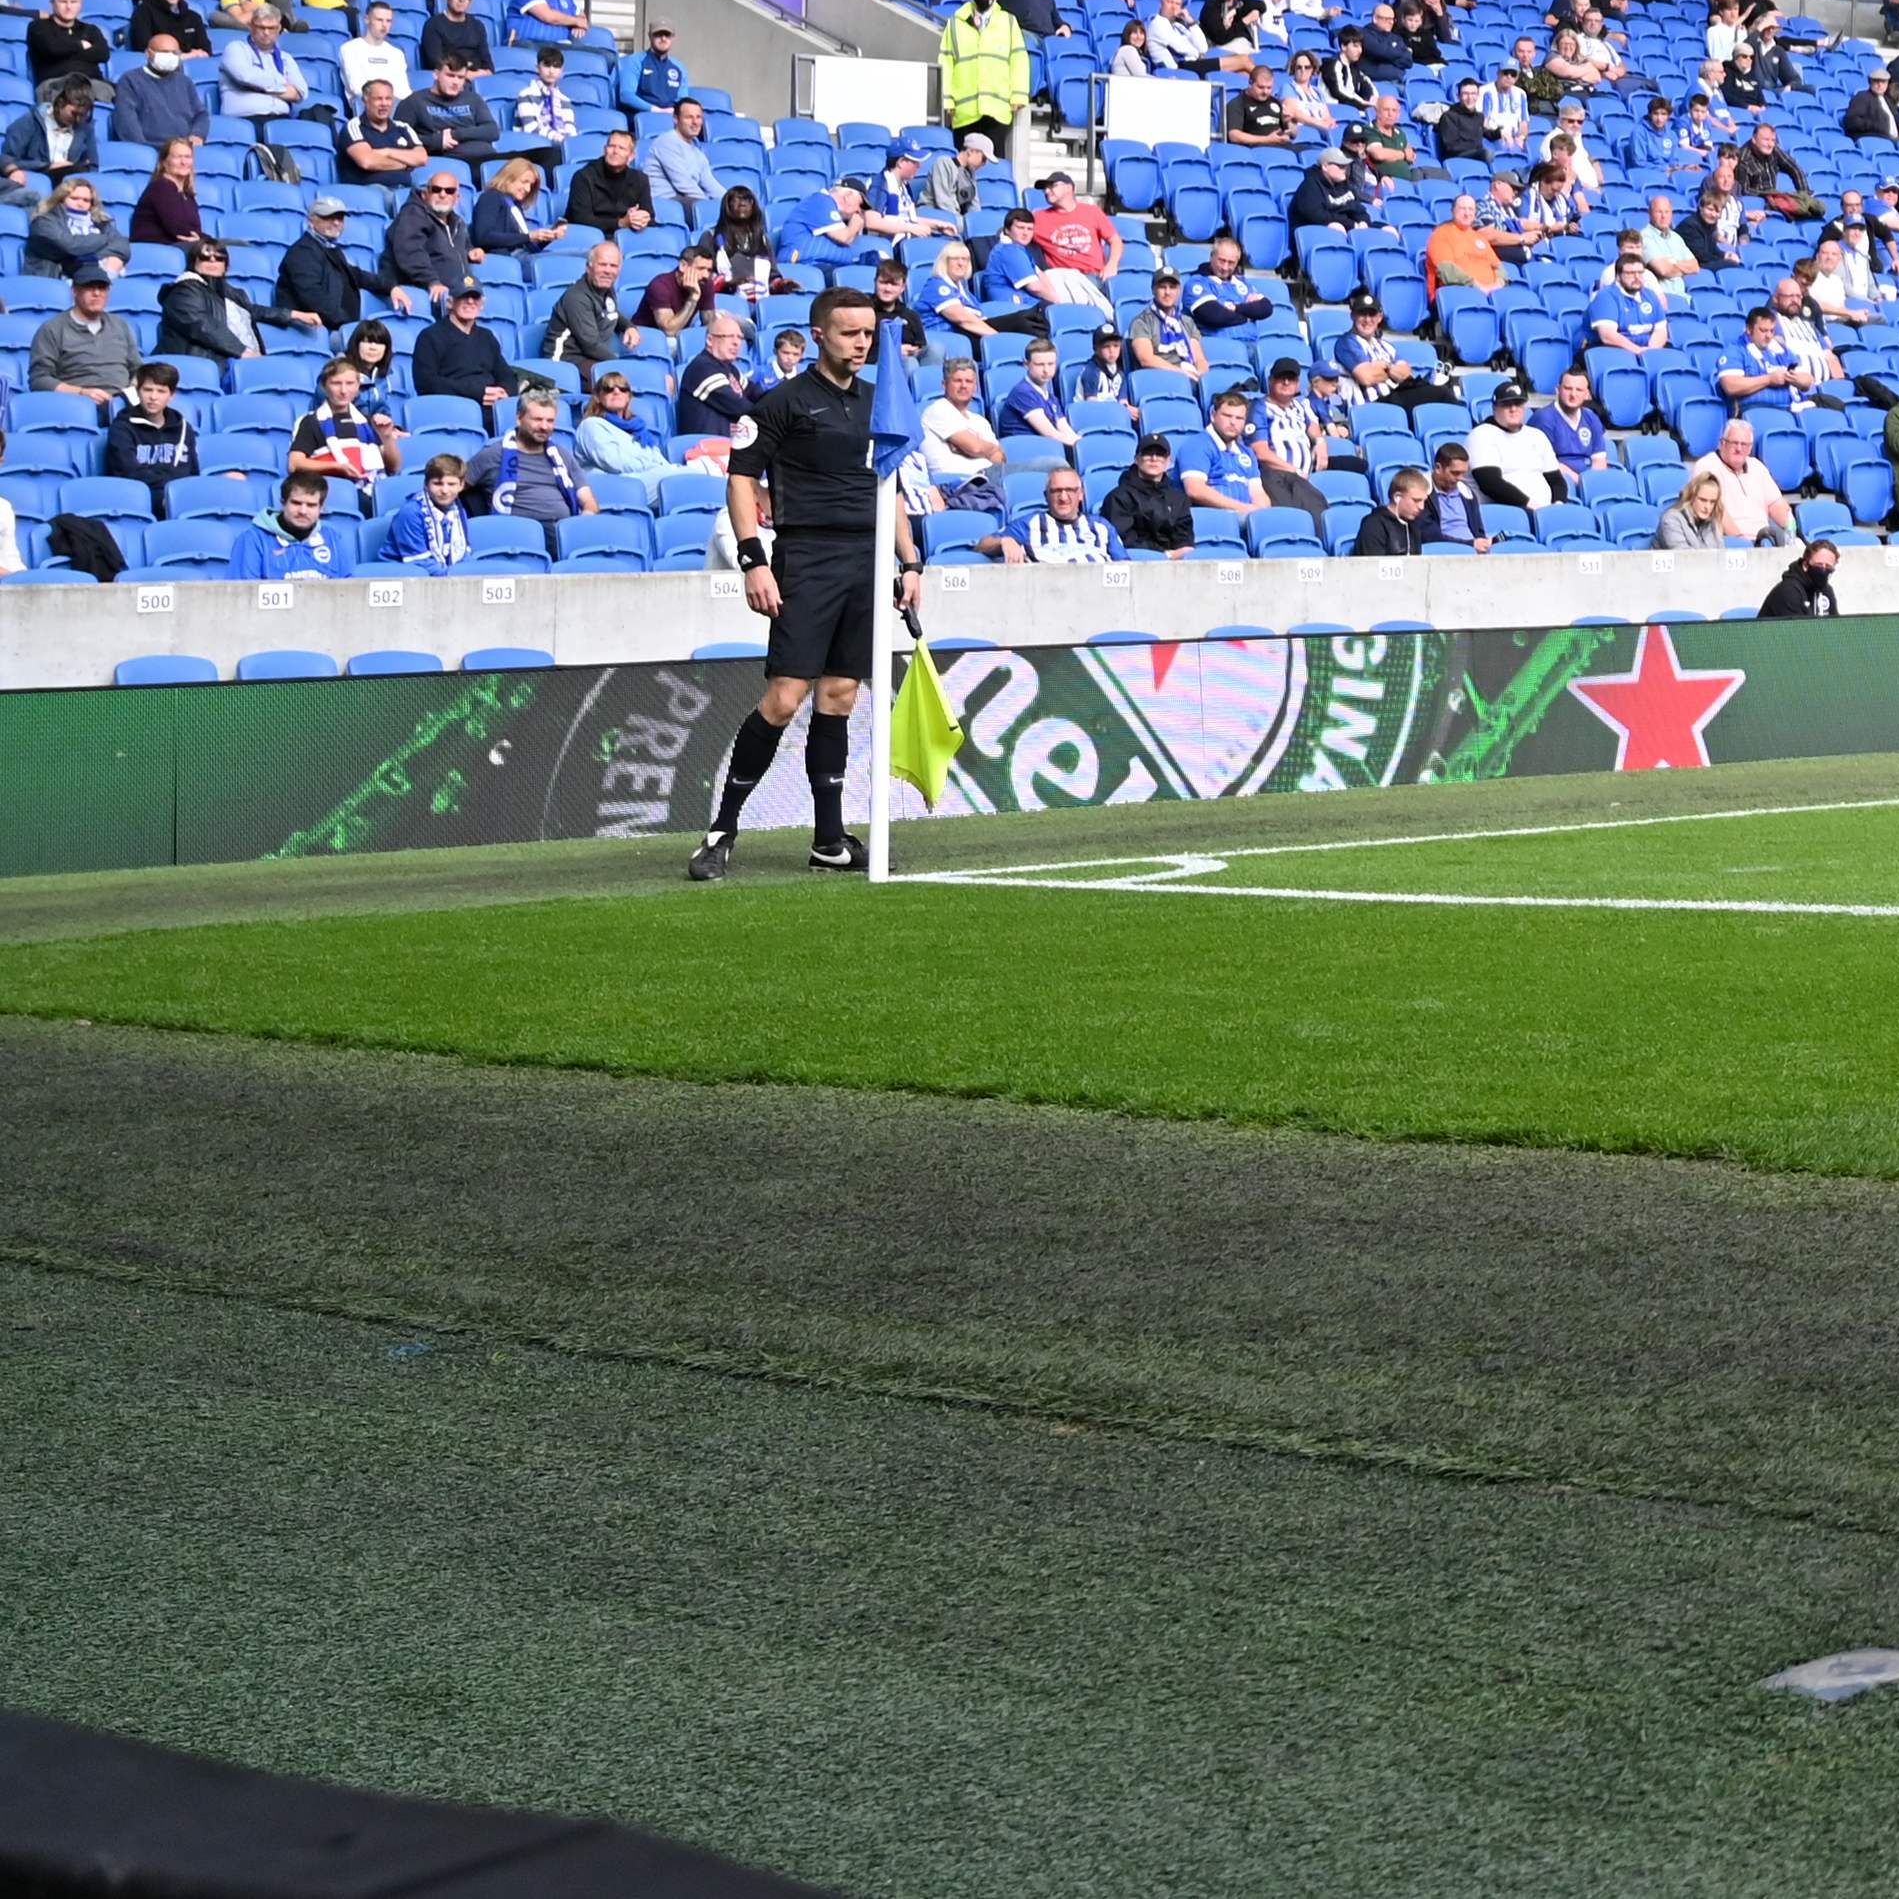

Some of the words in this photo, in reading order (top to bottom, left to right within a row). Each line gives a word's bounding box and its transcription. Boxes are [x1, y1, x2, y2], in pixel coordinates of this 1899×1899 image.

[1581, 559, 1600, 573] 511
[1654, 557, 1673, 571] 512
[1727, 555, 1747, 569] 513
[1105, 570, 1128, 585] 507
[1219, 569, 1242, 584] 508
[1300, 566, 1321, 581] 509
[1380, 565, 1401, 579] 510
[713, 580, 739, 595] 504
[943, 574, 968, 589] 506
[261, 591, 290, 606] 501
[372, 589, 400, 604] 502
[485, 586, 513, 601] 503
[140, 595, 171, 610] 500
